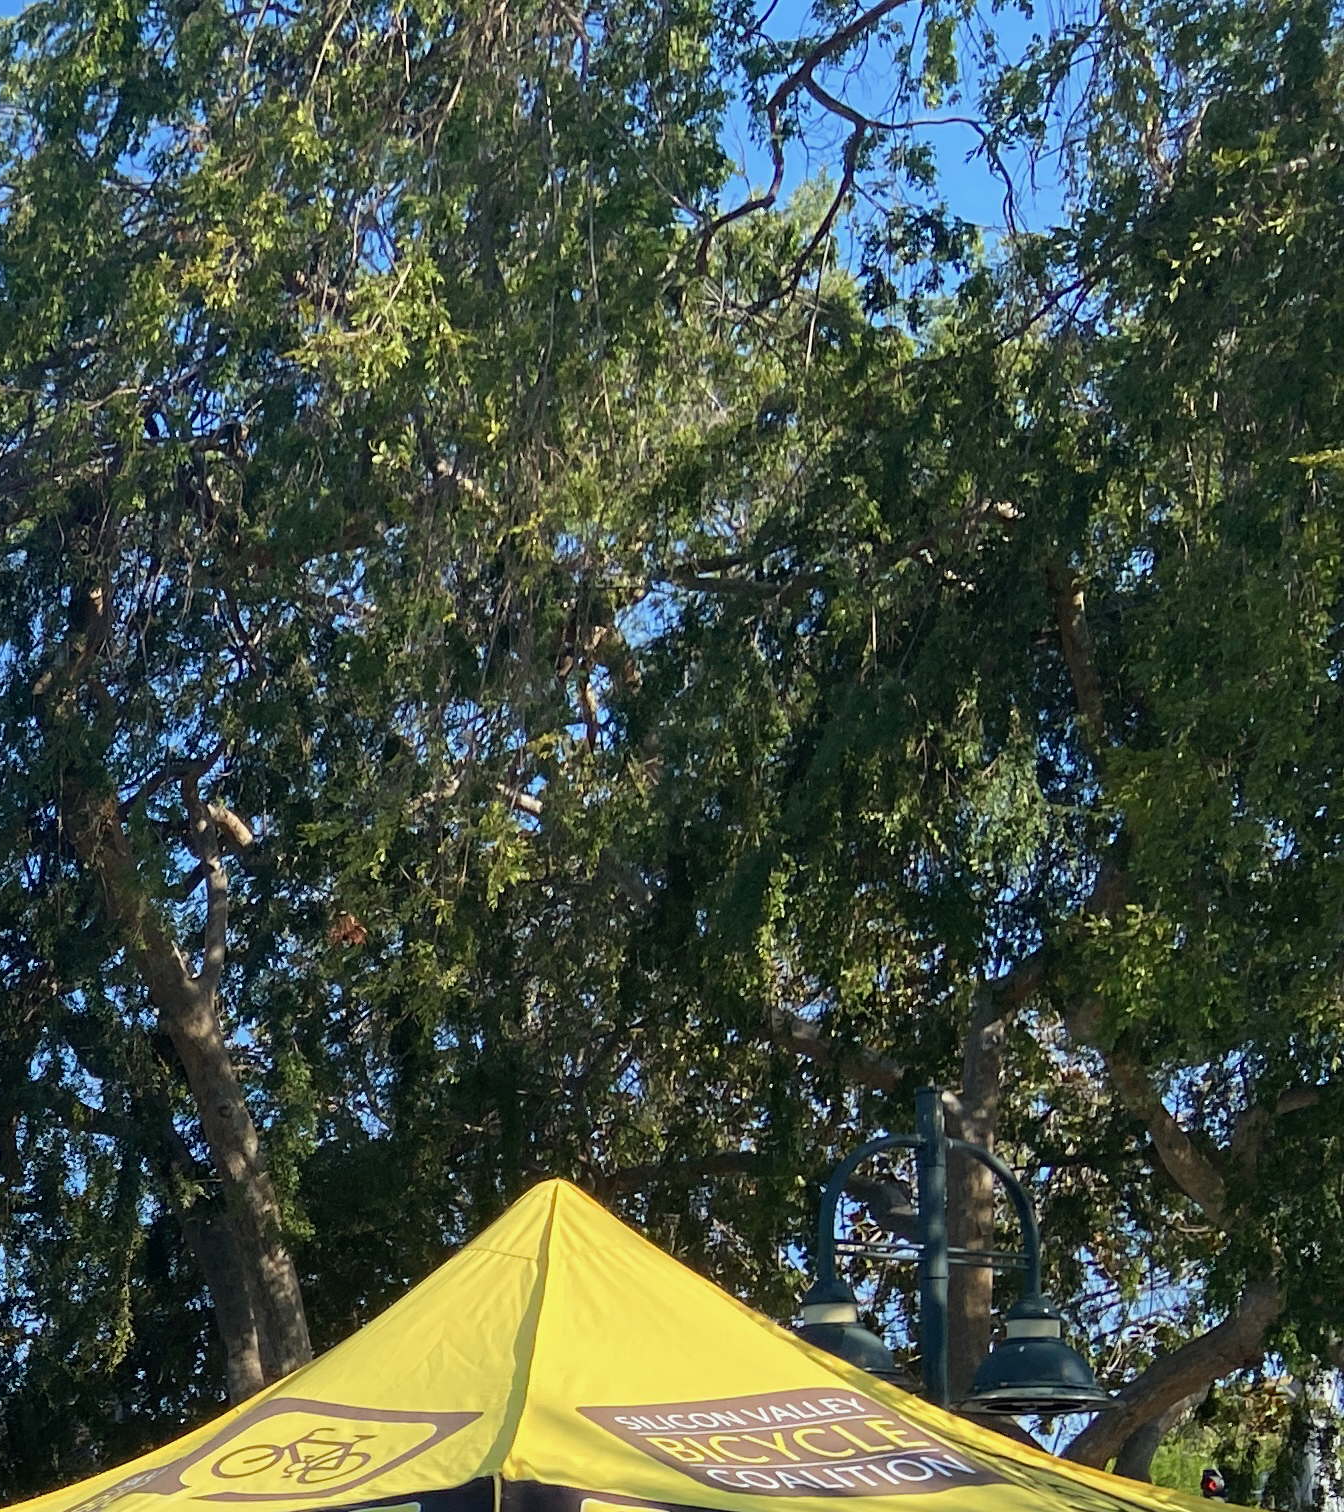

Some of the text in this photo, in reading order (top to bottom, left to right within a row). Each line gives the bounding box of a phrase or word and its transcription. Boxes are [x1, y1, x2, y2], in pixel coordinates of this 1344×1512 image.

[614, 1397, 869, 1431] SILICON VALLEY
[645, 1419, 932, 1464] BICYCLE
[706, 1454, 977, 1490] COALITION
